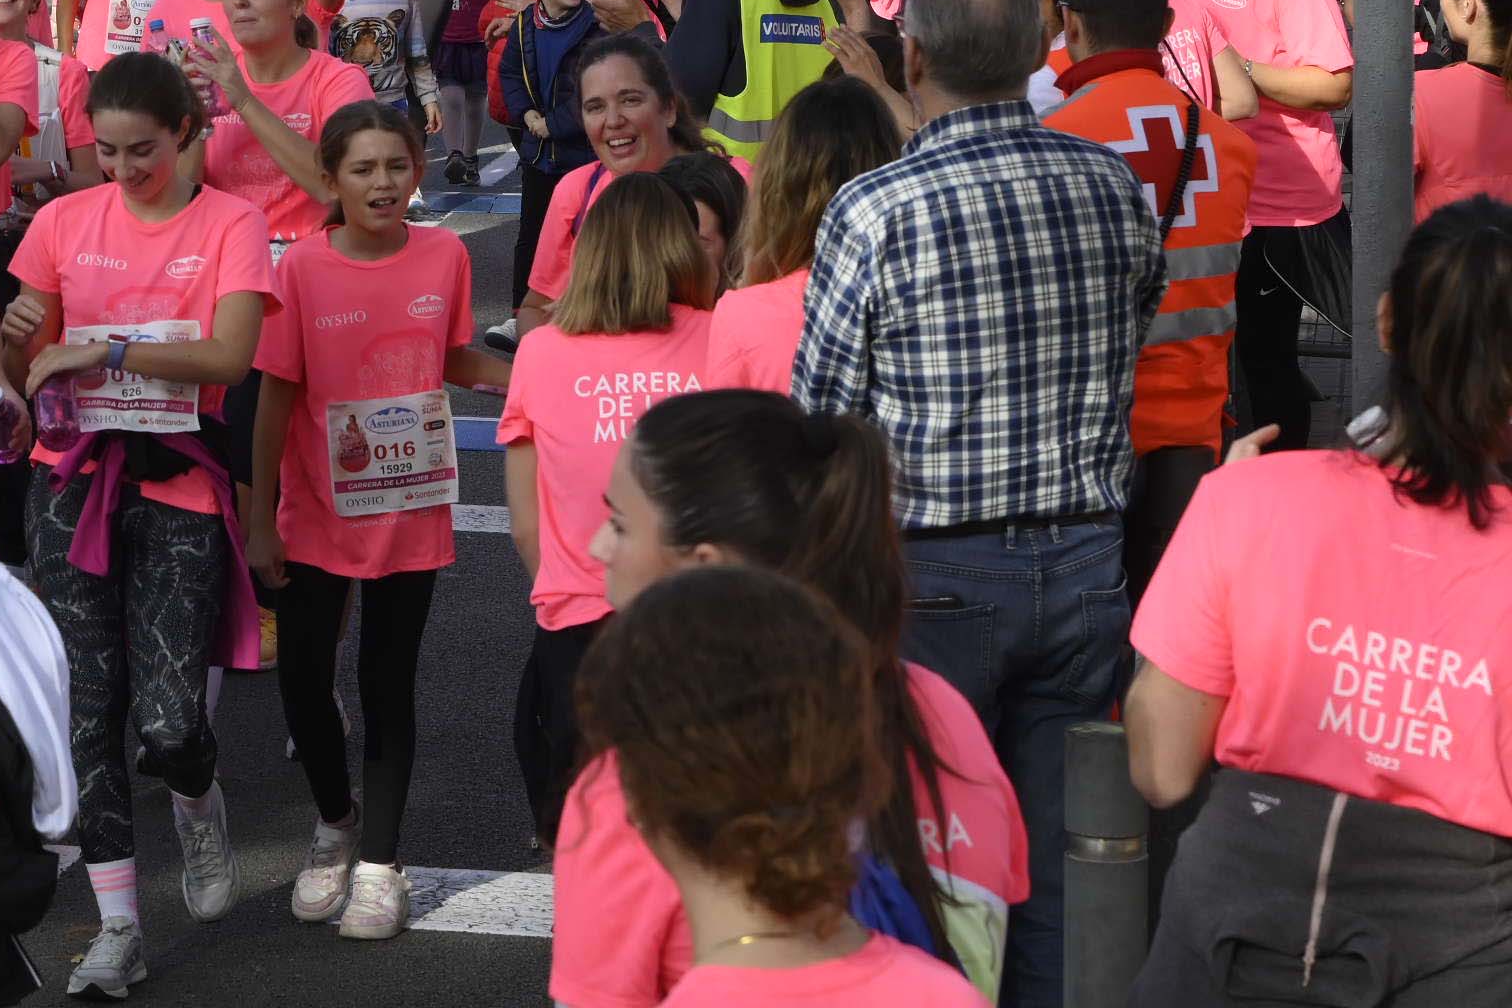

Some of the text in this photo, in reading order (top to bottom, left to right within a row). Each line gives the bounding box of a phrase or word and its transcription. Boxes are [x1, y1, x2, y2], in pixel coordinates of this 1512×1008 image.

[1178, 47, 1195, 65] LA
[76, 252, 128, 271] OYSHO
[315, 309, 368, 330] OYSHO
[121, 387, 143, 399] 626
[574, 372, 703, 398] CARRERA
[80, 399, 117, 407] CARRERA
[117, 401, 128, 409] DE
[129, 401, 139, 409] LA
[140, 401, 167, 409] MUJER
[598, 395, 634, 419] DE
[368, 416, 416, 430] ASTURIANA
[374, 441, 416, 460] 016
[379, 462, 413, 475] 15929
[347, 471, 447, 490] CARRERA DE LA MUJER 2023
[345, 487, 450, 508] OYSHO Santander
[1306, 616, 1493, 697] CARRERA
[1333, 661, 1449, 723] DE LA
[1318, 696, 1454, 762] MUJER
[1365, 750, 1401, 772] 2023
